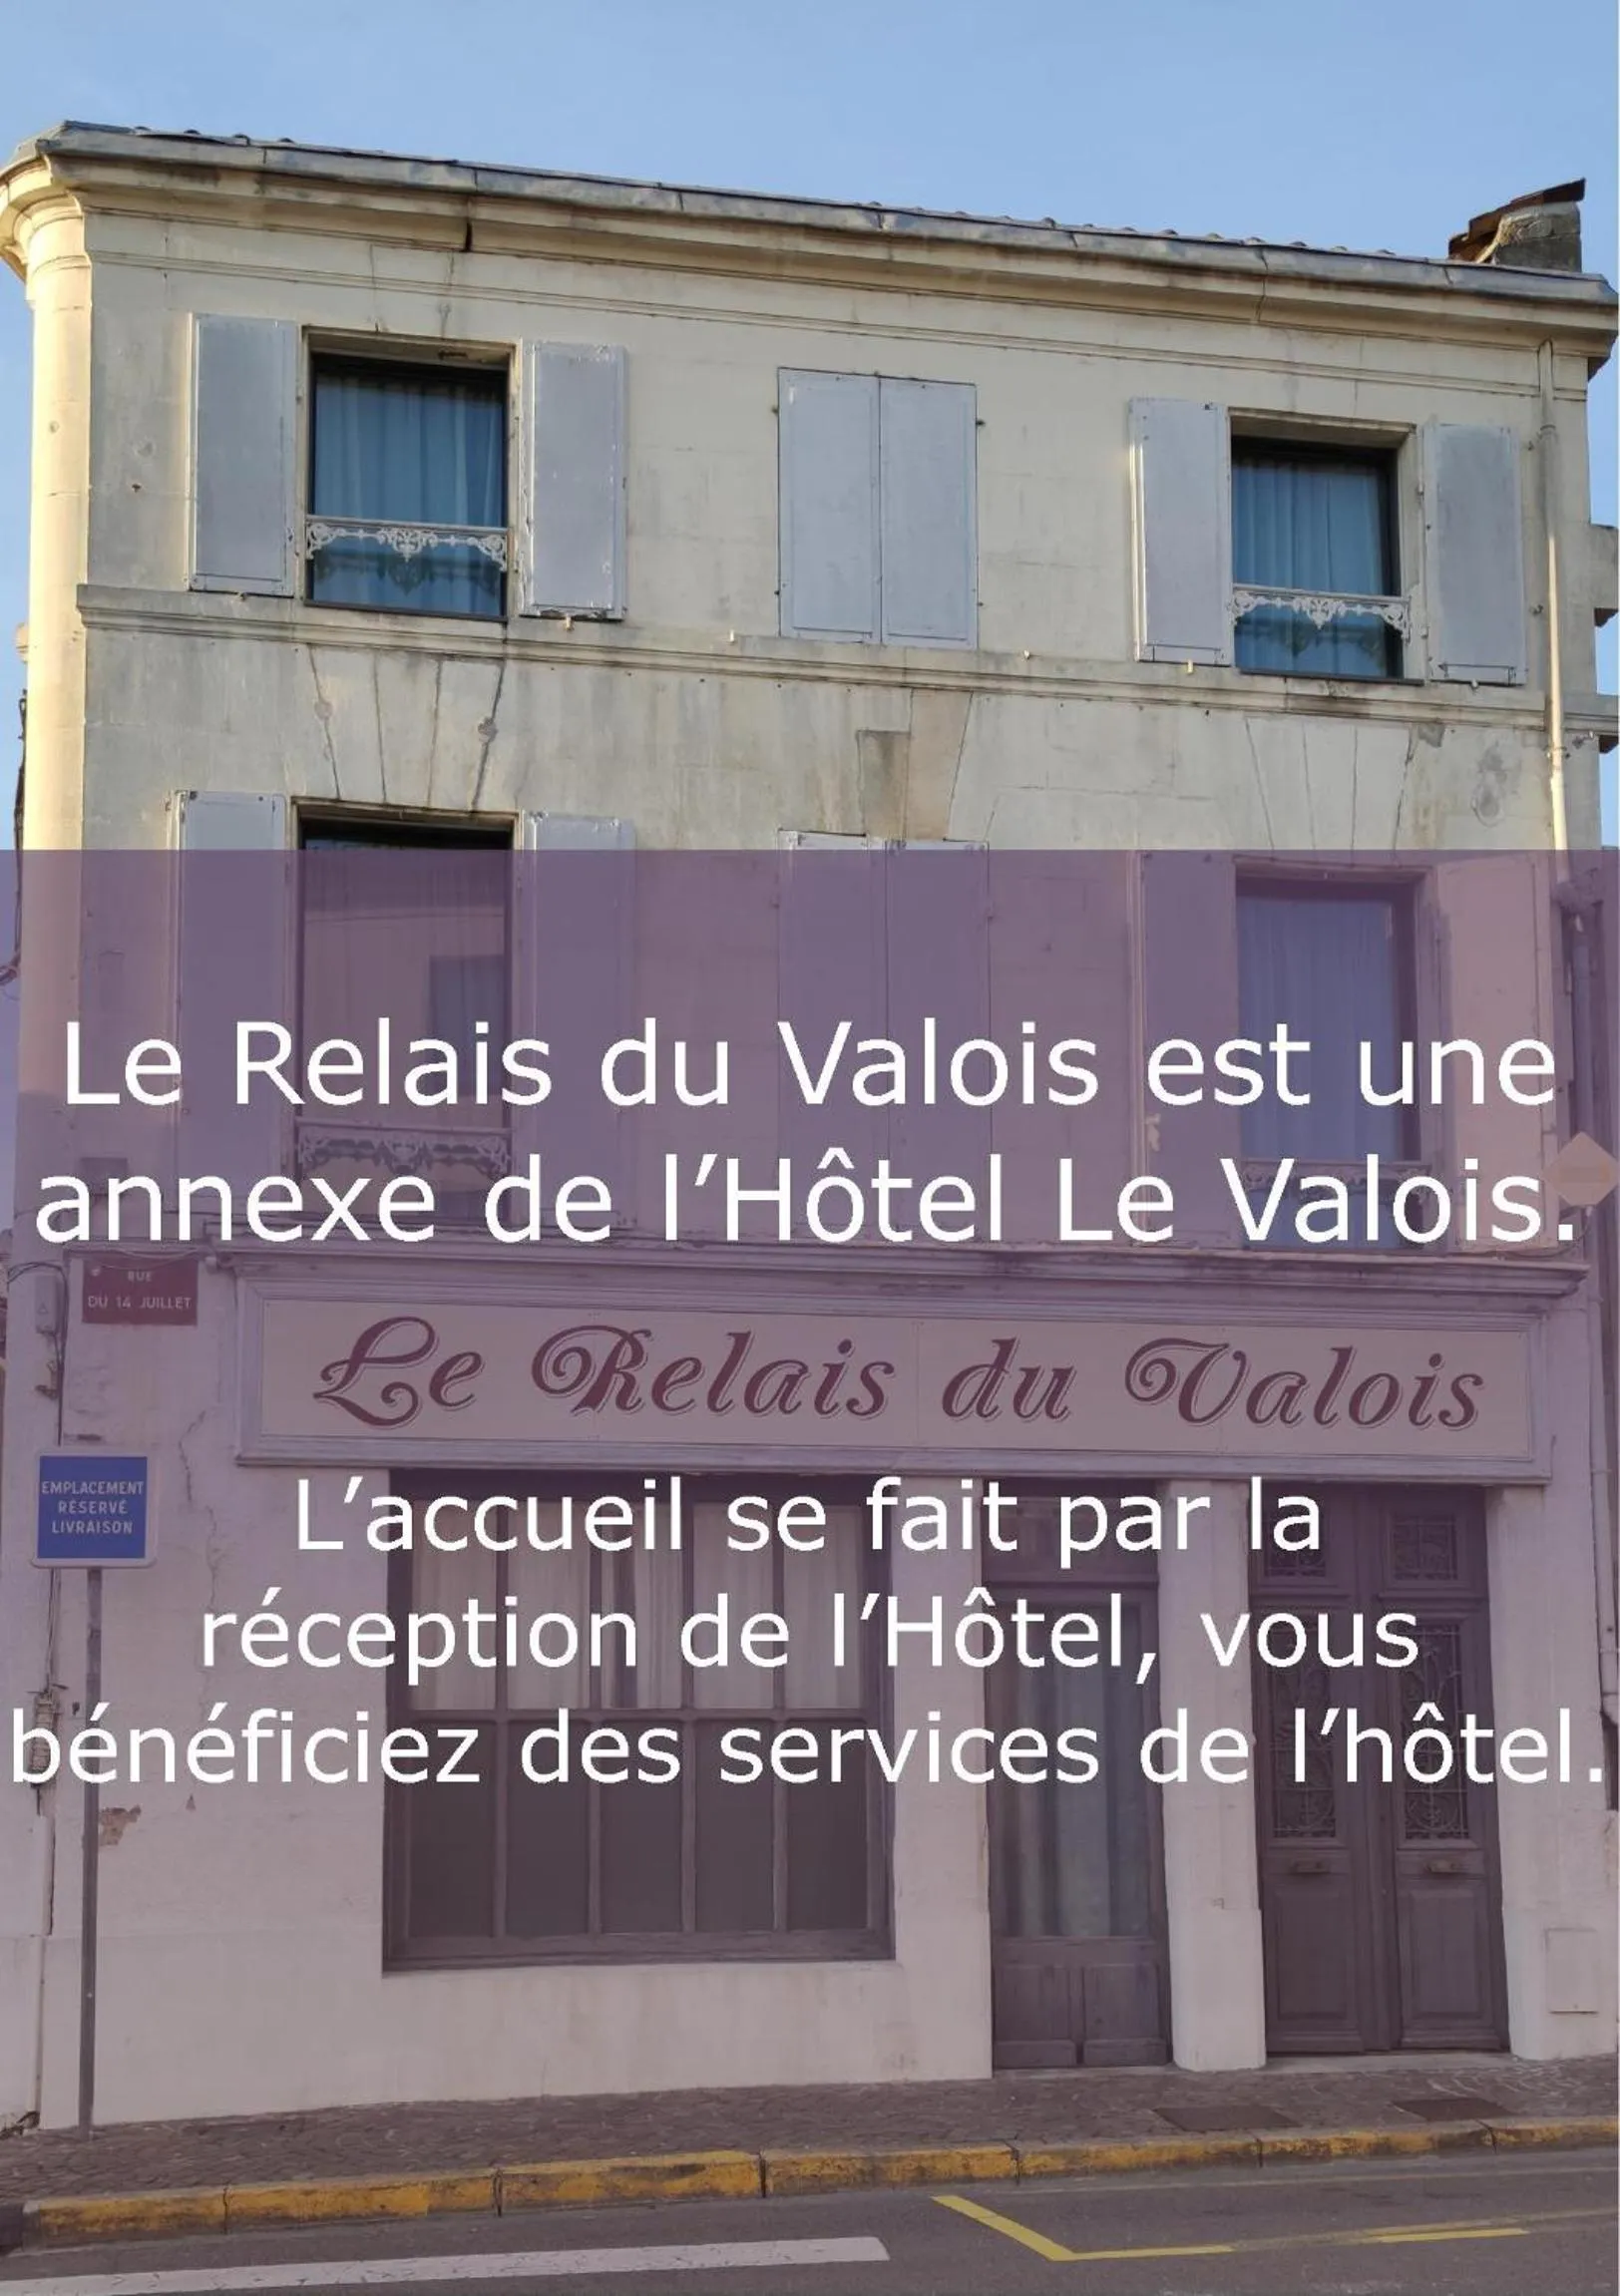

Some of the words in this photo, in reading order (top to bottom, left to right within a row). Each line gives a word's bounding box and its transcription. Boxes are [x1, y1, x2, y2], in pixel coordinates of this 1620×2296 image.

[128, 1270, 153, 1283] RUE
[88, 1296, 109, 1309] DU
[116, 1296, 132, 1310] 14
[140, 1296, 193, 1310] JUILLET
[312, 1316, 486, 1429] Le
[530, 1324, 896, 1420] Relais
[941, 1336, 1077, 1422] du
[1124, 1337, 1484, 1430] Valois
[41, 1480, 145, 1495] EMPLACEMENT
[58, 1498, 129, 1515] RÉSERVÉ
[51, 1520, 134, 1535] LIVRAISON
